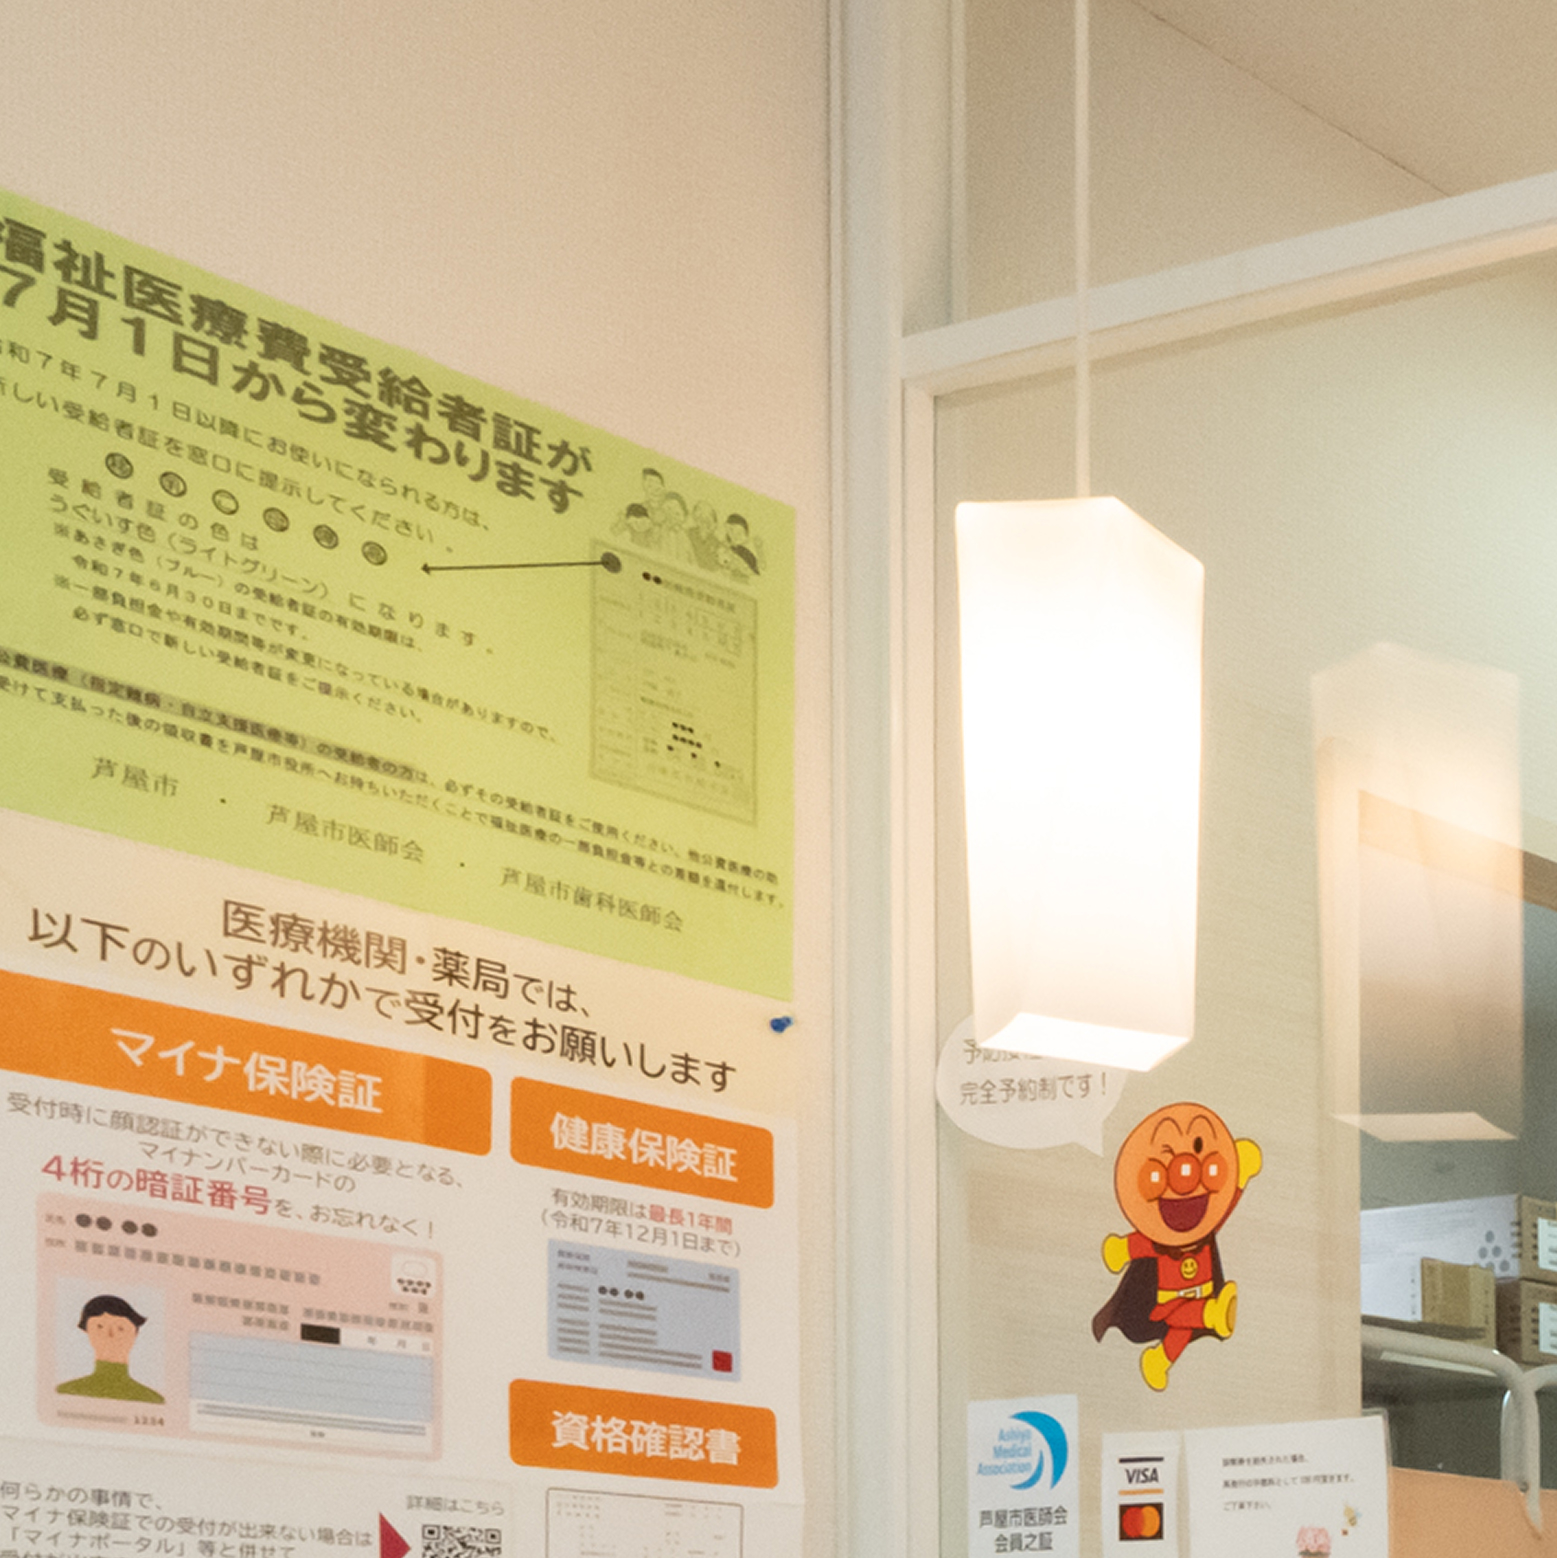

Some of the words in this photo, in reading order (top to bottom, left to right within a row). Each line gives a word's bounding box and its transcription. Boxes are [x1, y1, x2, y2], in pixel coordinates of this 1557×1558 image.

[0, 339, 490, 531] 和7年7月1日以降にお使いになられる方は、
[0, 376, 454, 554] しい受給者証を窓口に提示してください。
[91, 756, 179, 797] 芦屋市
[222, 899, 591, 1018] 医療機関・薬局では、
[27, 907, 737, 1093] 以下のいずれかで受付をお願いします
[110, 1027, 385, 1115] マイナ保険証
[137, 1140, 356, 1194] マイナンバーカードの
[549, 1111, 739, 1182] 健康保険証
[551, 1410, 741, 1466] 資格確認書
[1125, 1468, 1160, 1485] VISA
[979, 1505, 1068, 1529] 芦屋市医師会
[995, 1532, 1053, 1554] 会員之証
